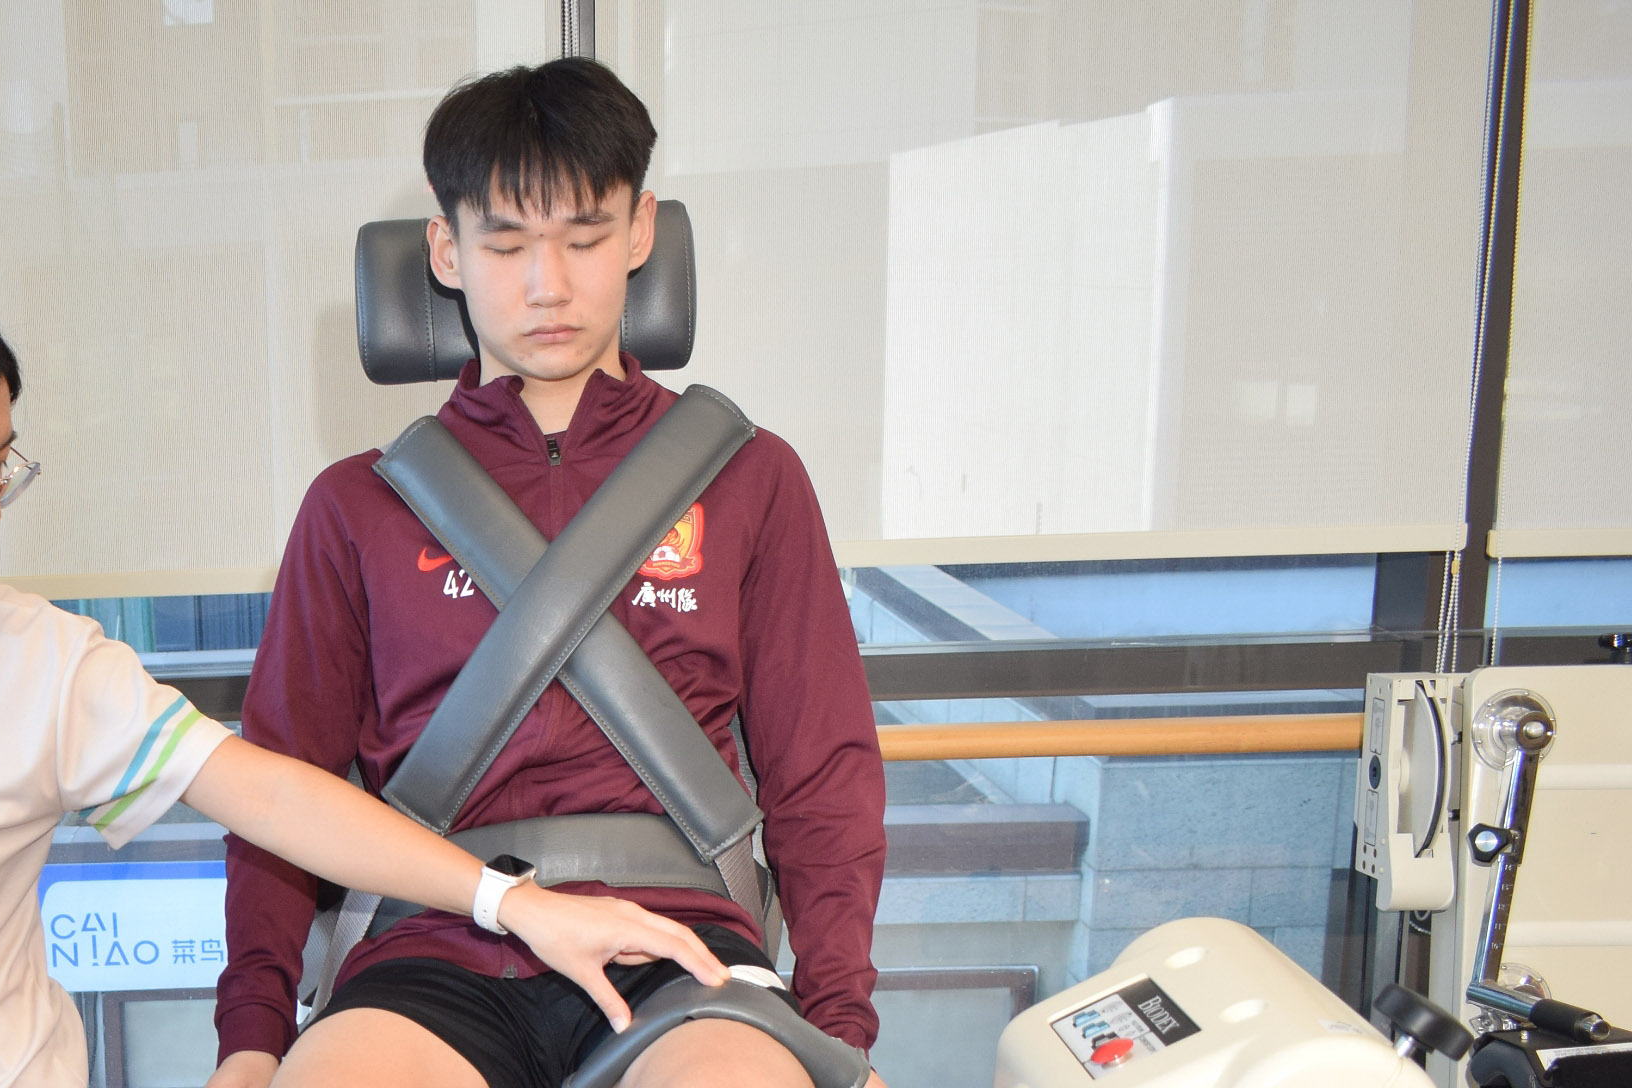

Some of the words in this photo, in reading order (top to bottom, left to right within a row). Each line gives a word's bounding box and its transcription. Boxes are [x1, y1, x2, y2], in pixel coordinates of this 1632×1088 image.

[443, 569, 475, 599] 42
[50, 912, 119, 940] CAI
[171, 938, 224, 965] 菜鸟
[1137, 995, 1180, 1034] BIODEX
